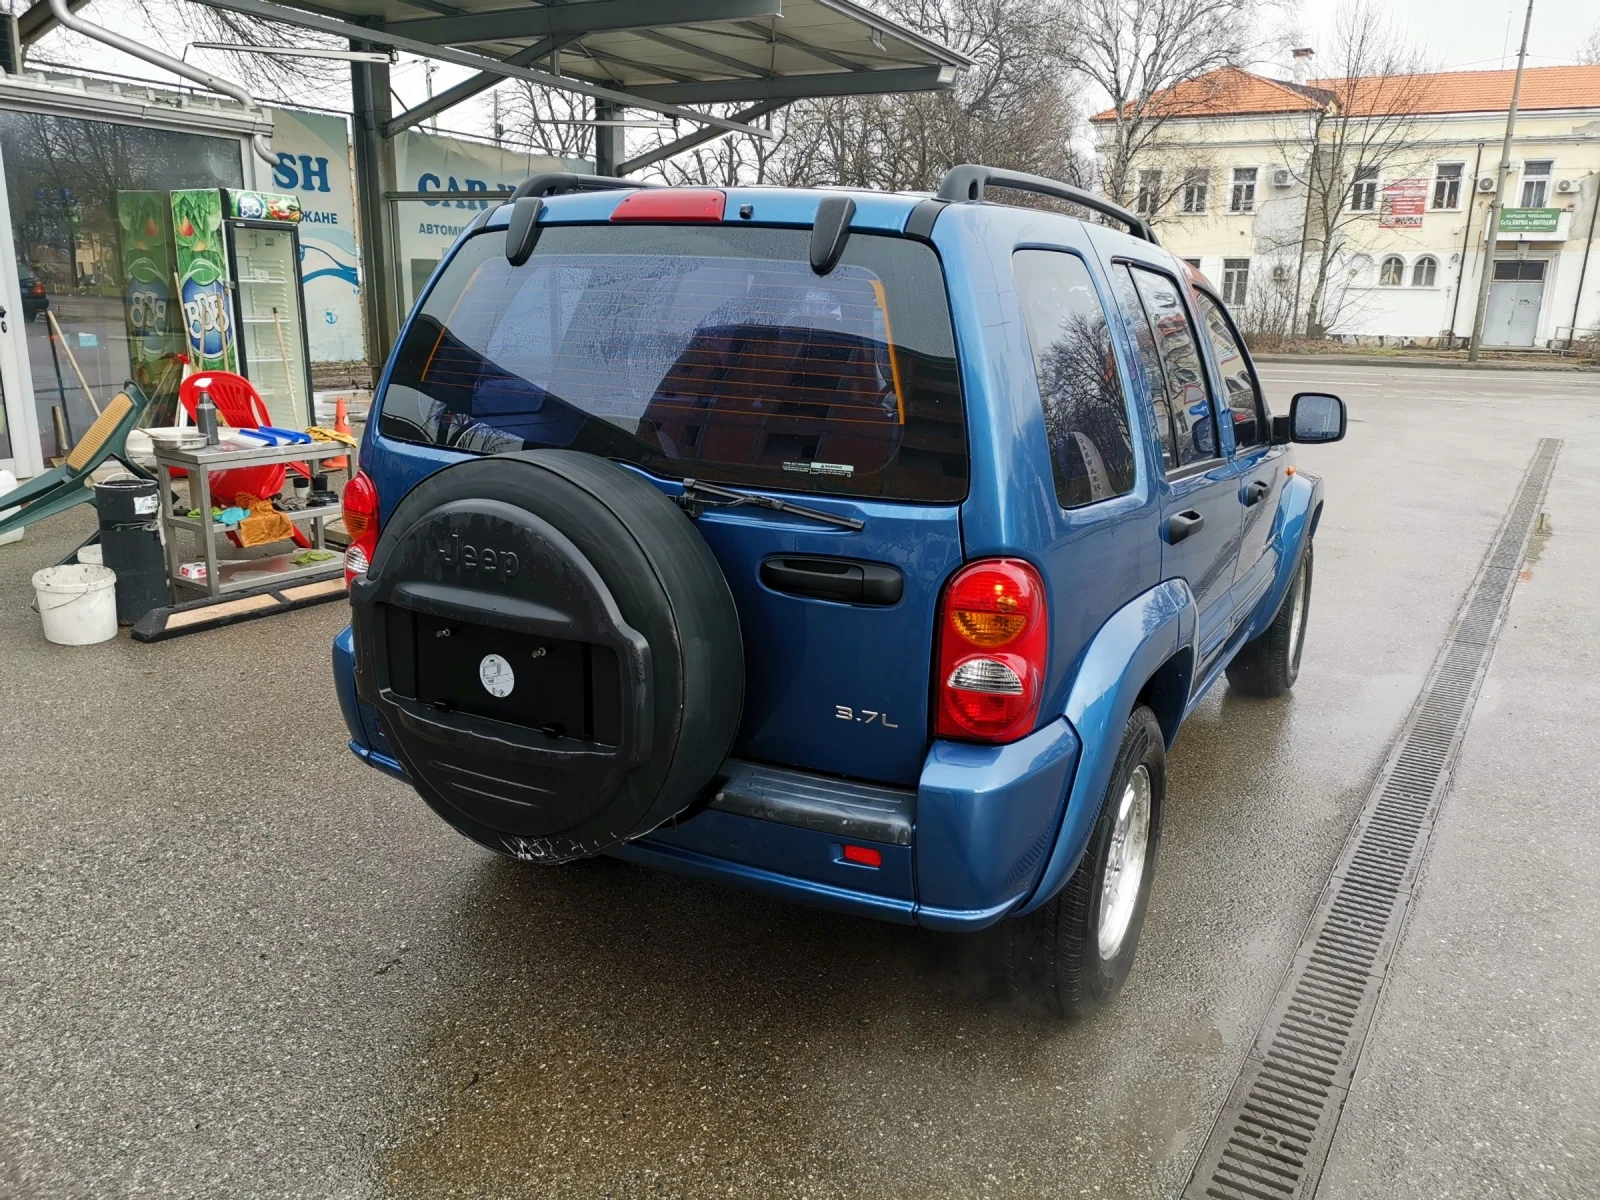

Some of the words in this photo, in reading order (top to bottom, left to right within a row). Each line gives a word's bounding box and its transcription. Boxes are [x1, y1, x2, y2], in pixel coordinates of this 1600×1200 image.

[418, 172, 489, 211] CAR
[439, 533, 519, 584] Jeep
[835, 704, 899, 729] 3.7L
